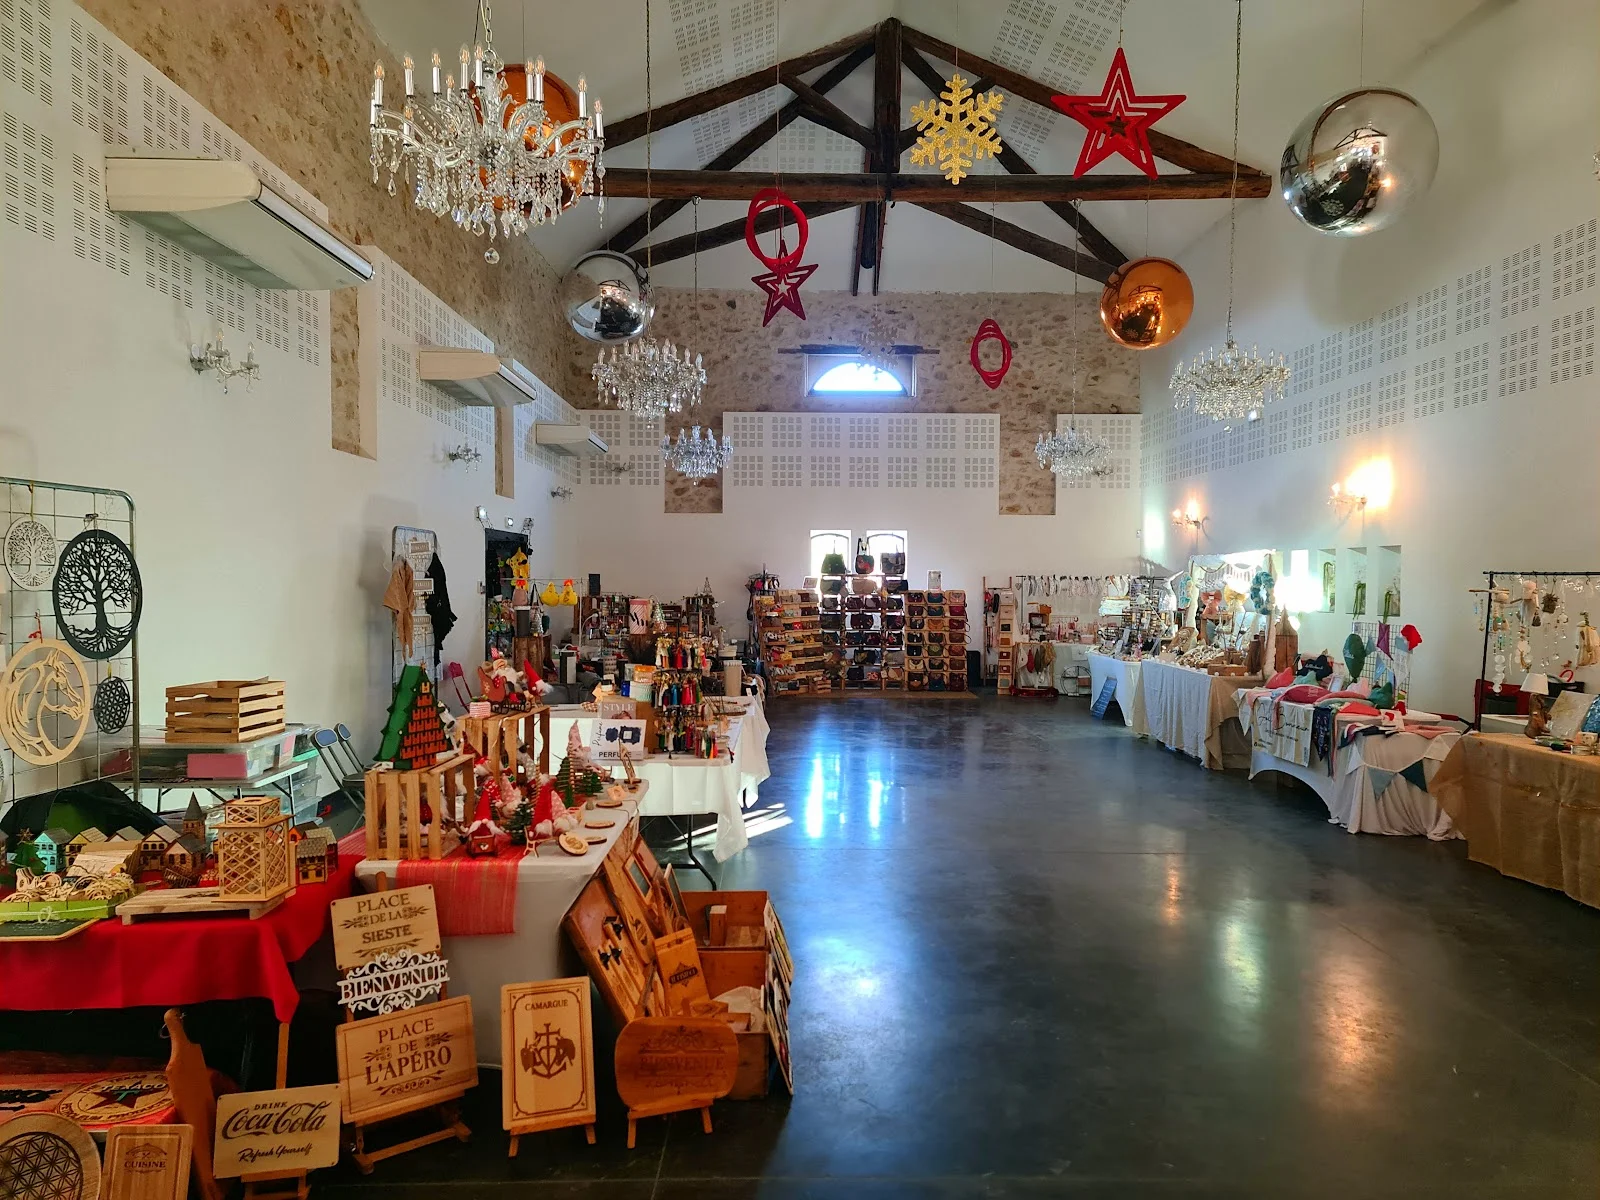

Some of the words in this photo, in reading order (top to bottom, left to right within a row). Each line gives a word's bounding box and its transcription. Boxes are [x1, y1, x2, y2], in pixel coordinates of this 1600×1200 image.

[603, 703, 634, 711] STYLE
[356, 892, 411, 913] PLACE
[370, 912, 387, 925] DE
[388, 910, 403, 921] LA
[362, 924, 413, 944] SIESTE
[339, 961, 449, 1003] BIENVENUE
[524, 999, 569, 1011] CAMARGUE
[378, 1018, 435, 1044] PLACE
[398, 1040, 418, 1054] DE
[365, 1045, 452, 1086] L'APÉRO
[101, 1083, 168, 1093] TEXACO
[253, 1101, 289, 1111] DRINK
[221, 1100, 333, 1140] Coca-Cola
[237, 1147, 275, 1163] Refresh
[275, 1142, 313, 1158] Yourself
[123, 1160, 167, 1169] CUISINE
